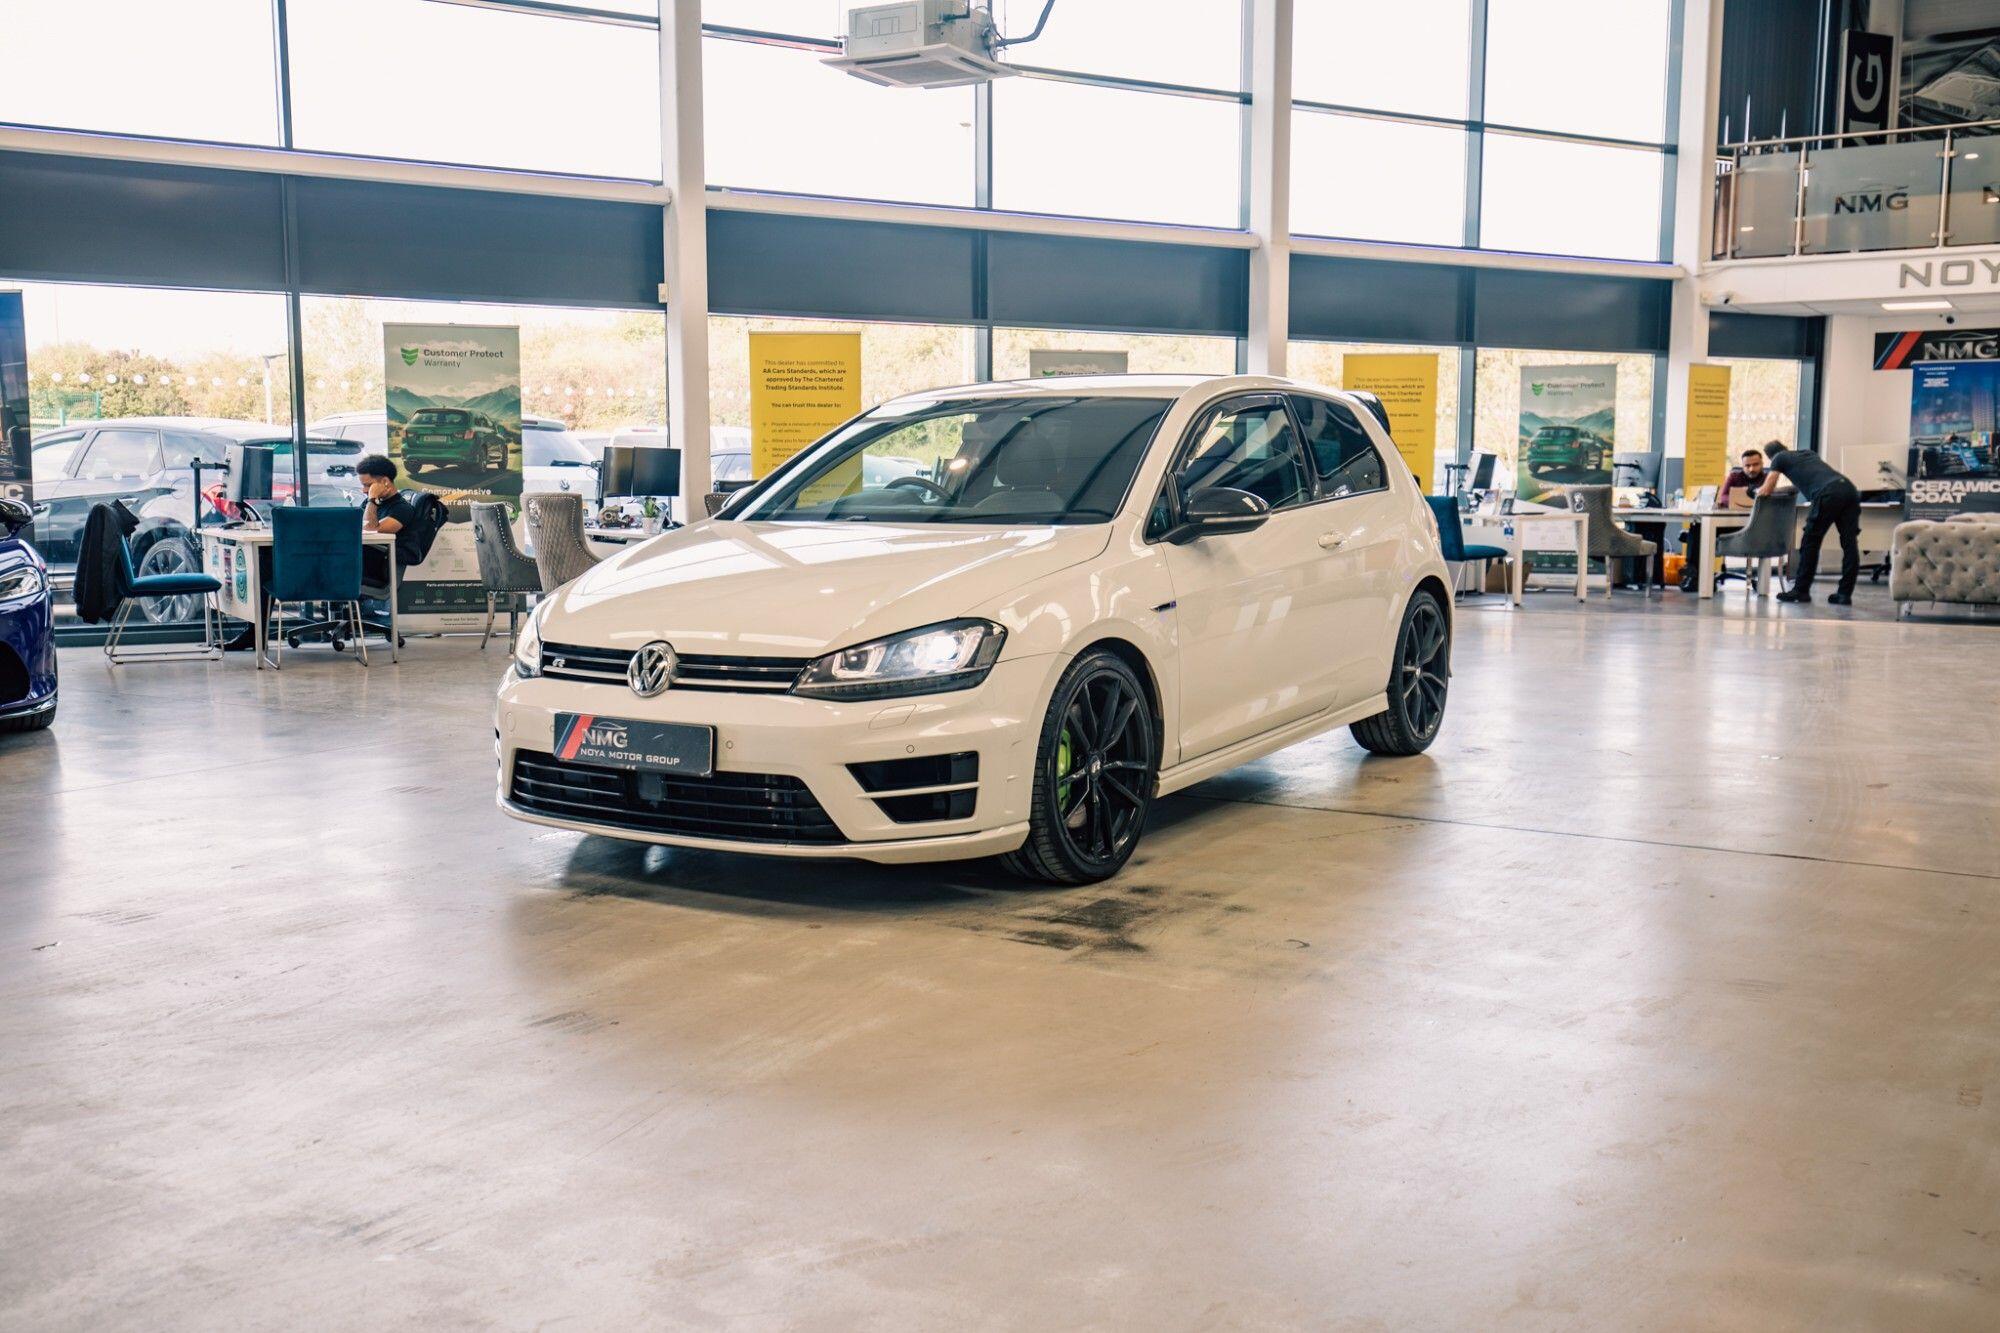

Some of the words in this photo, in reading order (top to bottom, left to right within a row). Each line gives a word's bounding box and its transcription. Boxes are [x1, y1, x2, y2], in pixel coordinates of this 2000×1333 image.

[1834, 193, 1909, 214] NMG
[424, 349, 467, 357] Customer
[470, 349, 503, 358] Protect
[1923, 340, 1998, 360] NMG
[424, 360, 461, 368] Warranty
[422, 488, 492, 497] Comprehensive
[1911, 480, 2000, 493] CERAMIC
[1911, 492, 1967, 504] COAT
[582, 729, 627, 748] NMG
[580, 748, 605, 757] NOYA
[608, 751, 643, 762] MOTOR
[645, 755, 680, 766] GROUP
